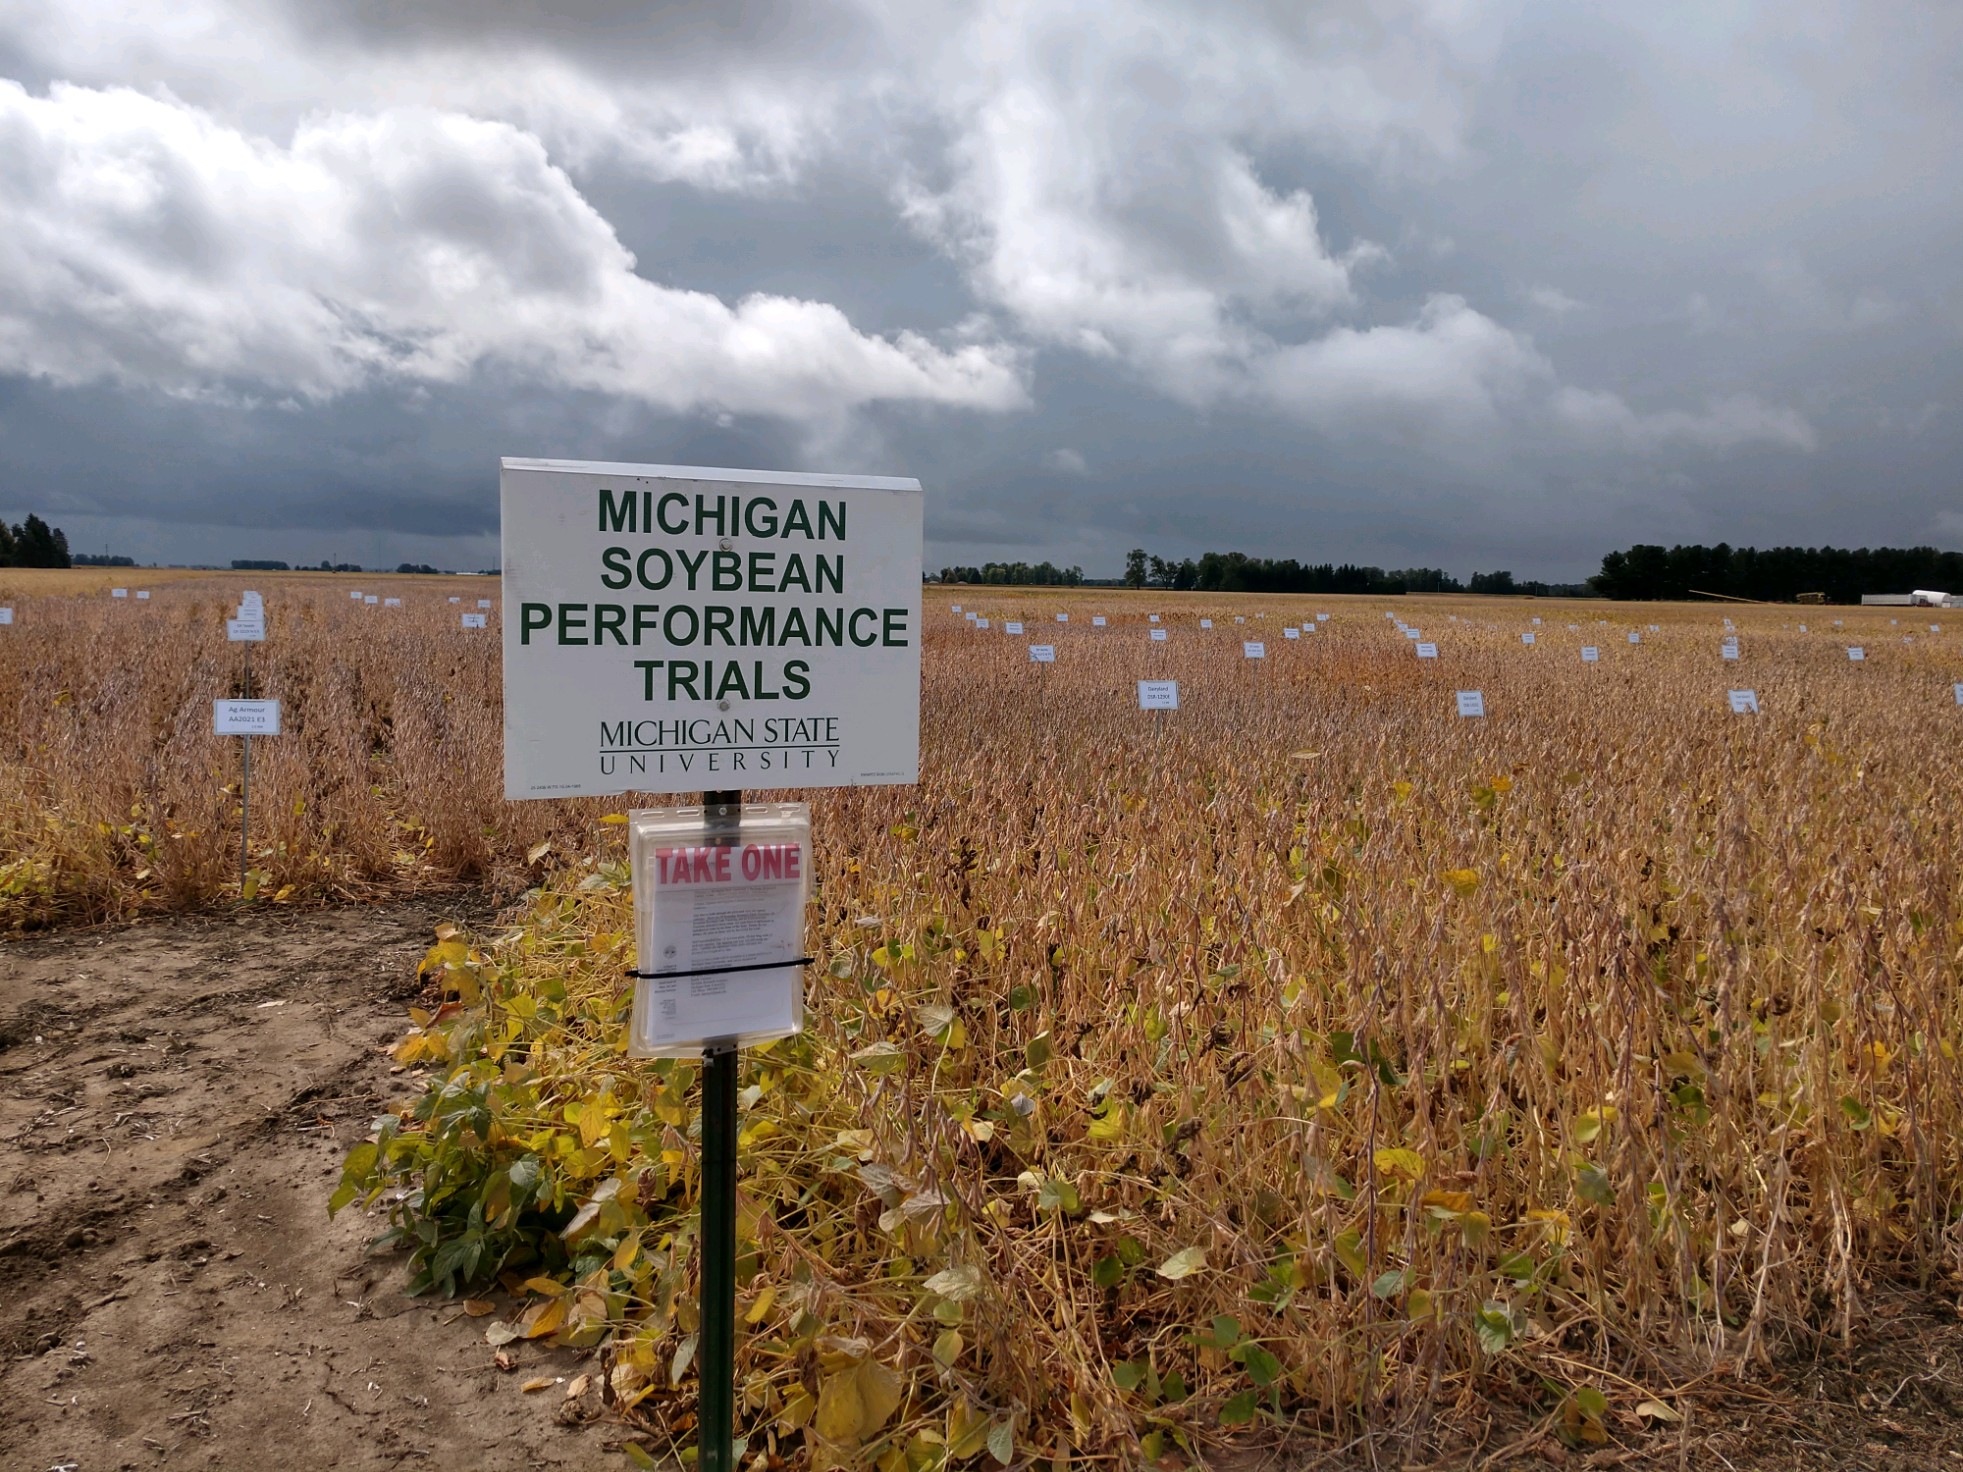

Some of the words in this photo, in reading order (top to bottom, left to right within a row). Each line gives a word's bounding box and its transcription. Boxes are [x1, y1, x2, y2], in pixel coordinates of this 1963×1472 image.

[599, 489, 847, 541] MICHIGAN
[601, 547, 844, 594] SOYBEAN
[520, 603, 909, 647] PERFORMANCE
[634, 659, 811, 702] TRIALS
[600, 720, 755, 747] MICHIGAN
[763, 717, 840, 743] STATE
[600, 750, 840, 775] UNIVERSITY
[655, 846, 731, 885] TAKE
[741, 843, 801, 881] ONE
